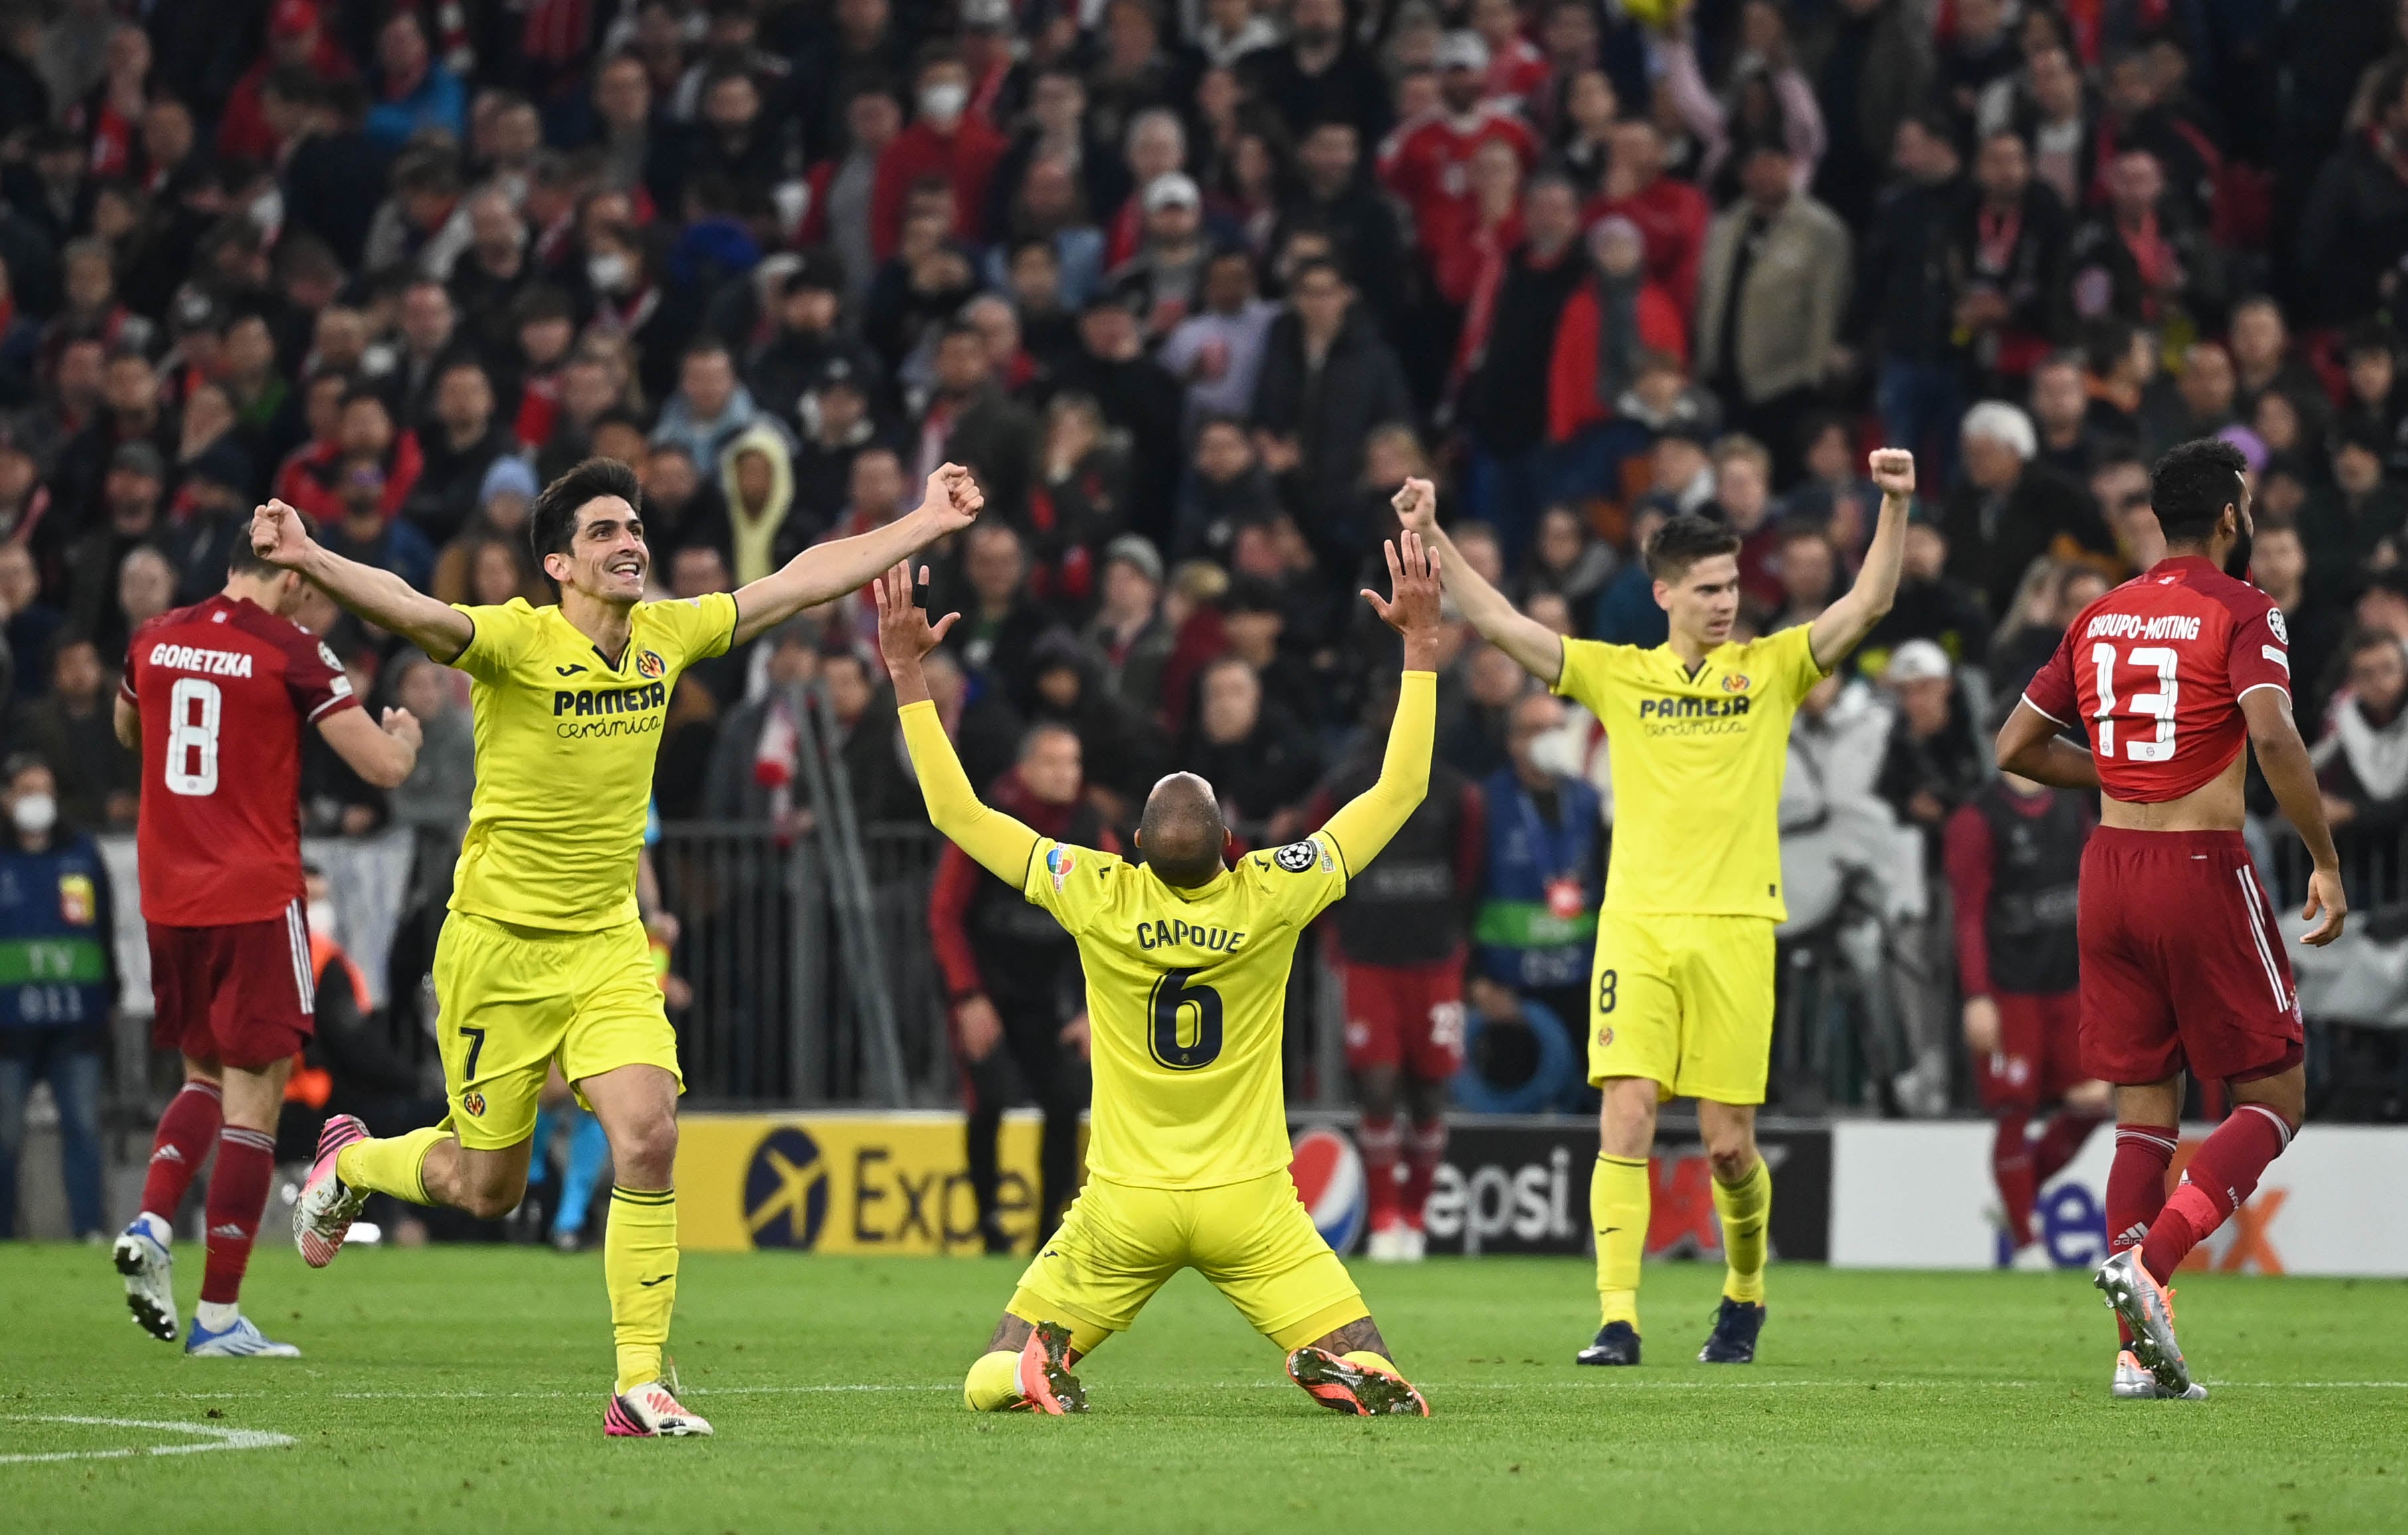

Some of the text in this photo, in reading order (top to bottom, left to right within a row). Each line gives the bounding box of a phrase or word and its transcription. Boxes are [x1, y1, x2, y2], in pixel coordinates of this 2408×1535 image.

[2086, 613, 2201, 640] CHOUPO-MOTING
[149, 643, 252, 678] GORETZKA
[553, 681, 665, 716] PAMESA
[1640, 695, 1750, 718] PAMESA
[2091, 643, 2178, 762] 13
[165, 677, 222, 796] 8
[557, 715, 660, 739] cerámica
[1137, 918, 1246, 954] CAPOUE
[1599, 970, 1618, 1014] 8
[1148, 967, 1223, 1071] 6
[458, 1025, 485, 1082] 7
[854, 1146, 1037, 1256] Expe
[1421, 1144, 1575, 1258] epsi
